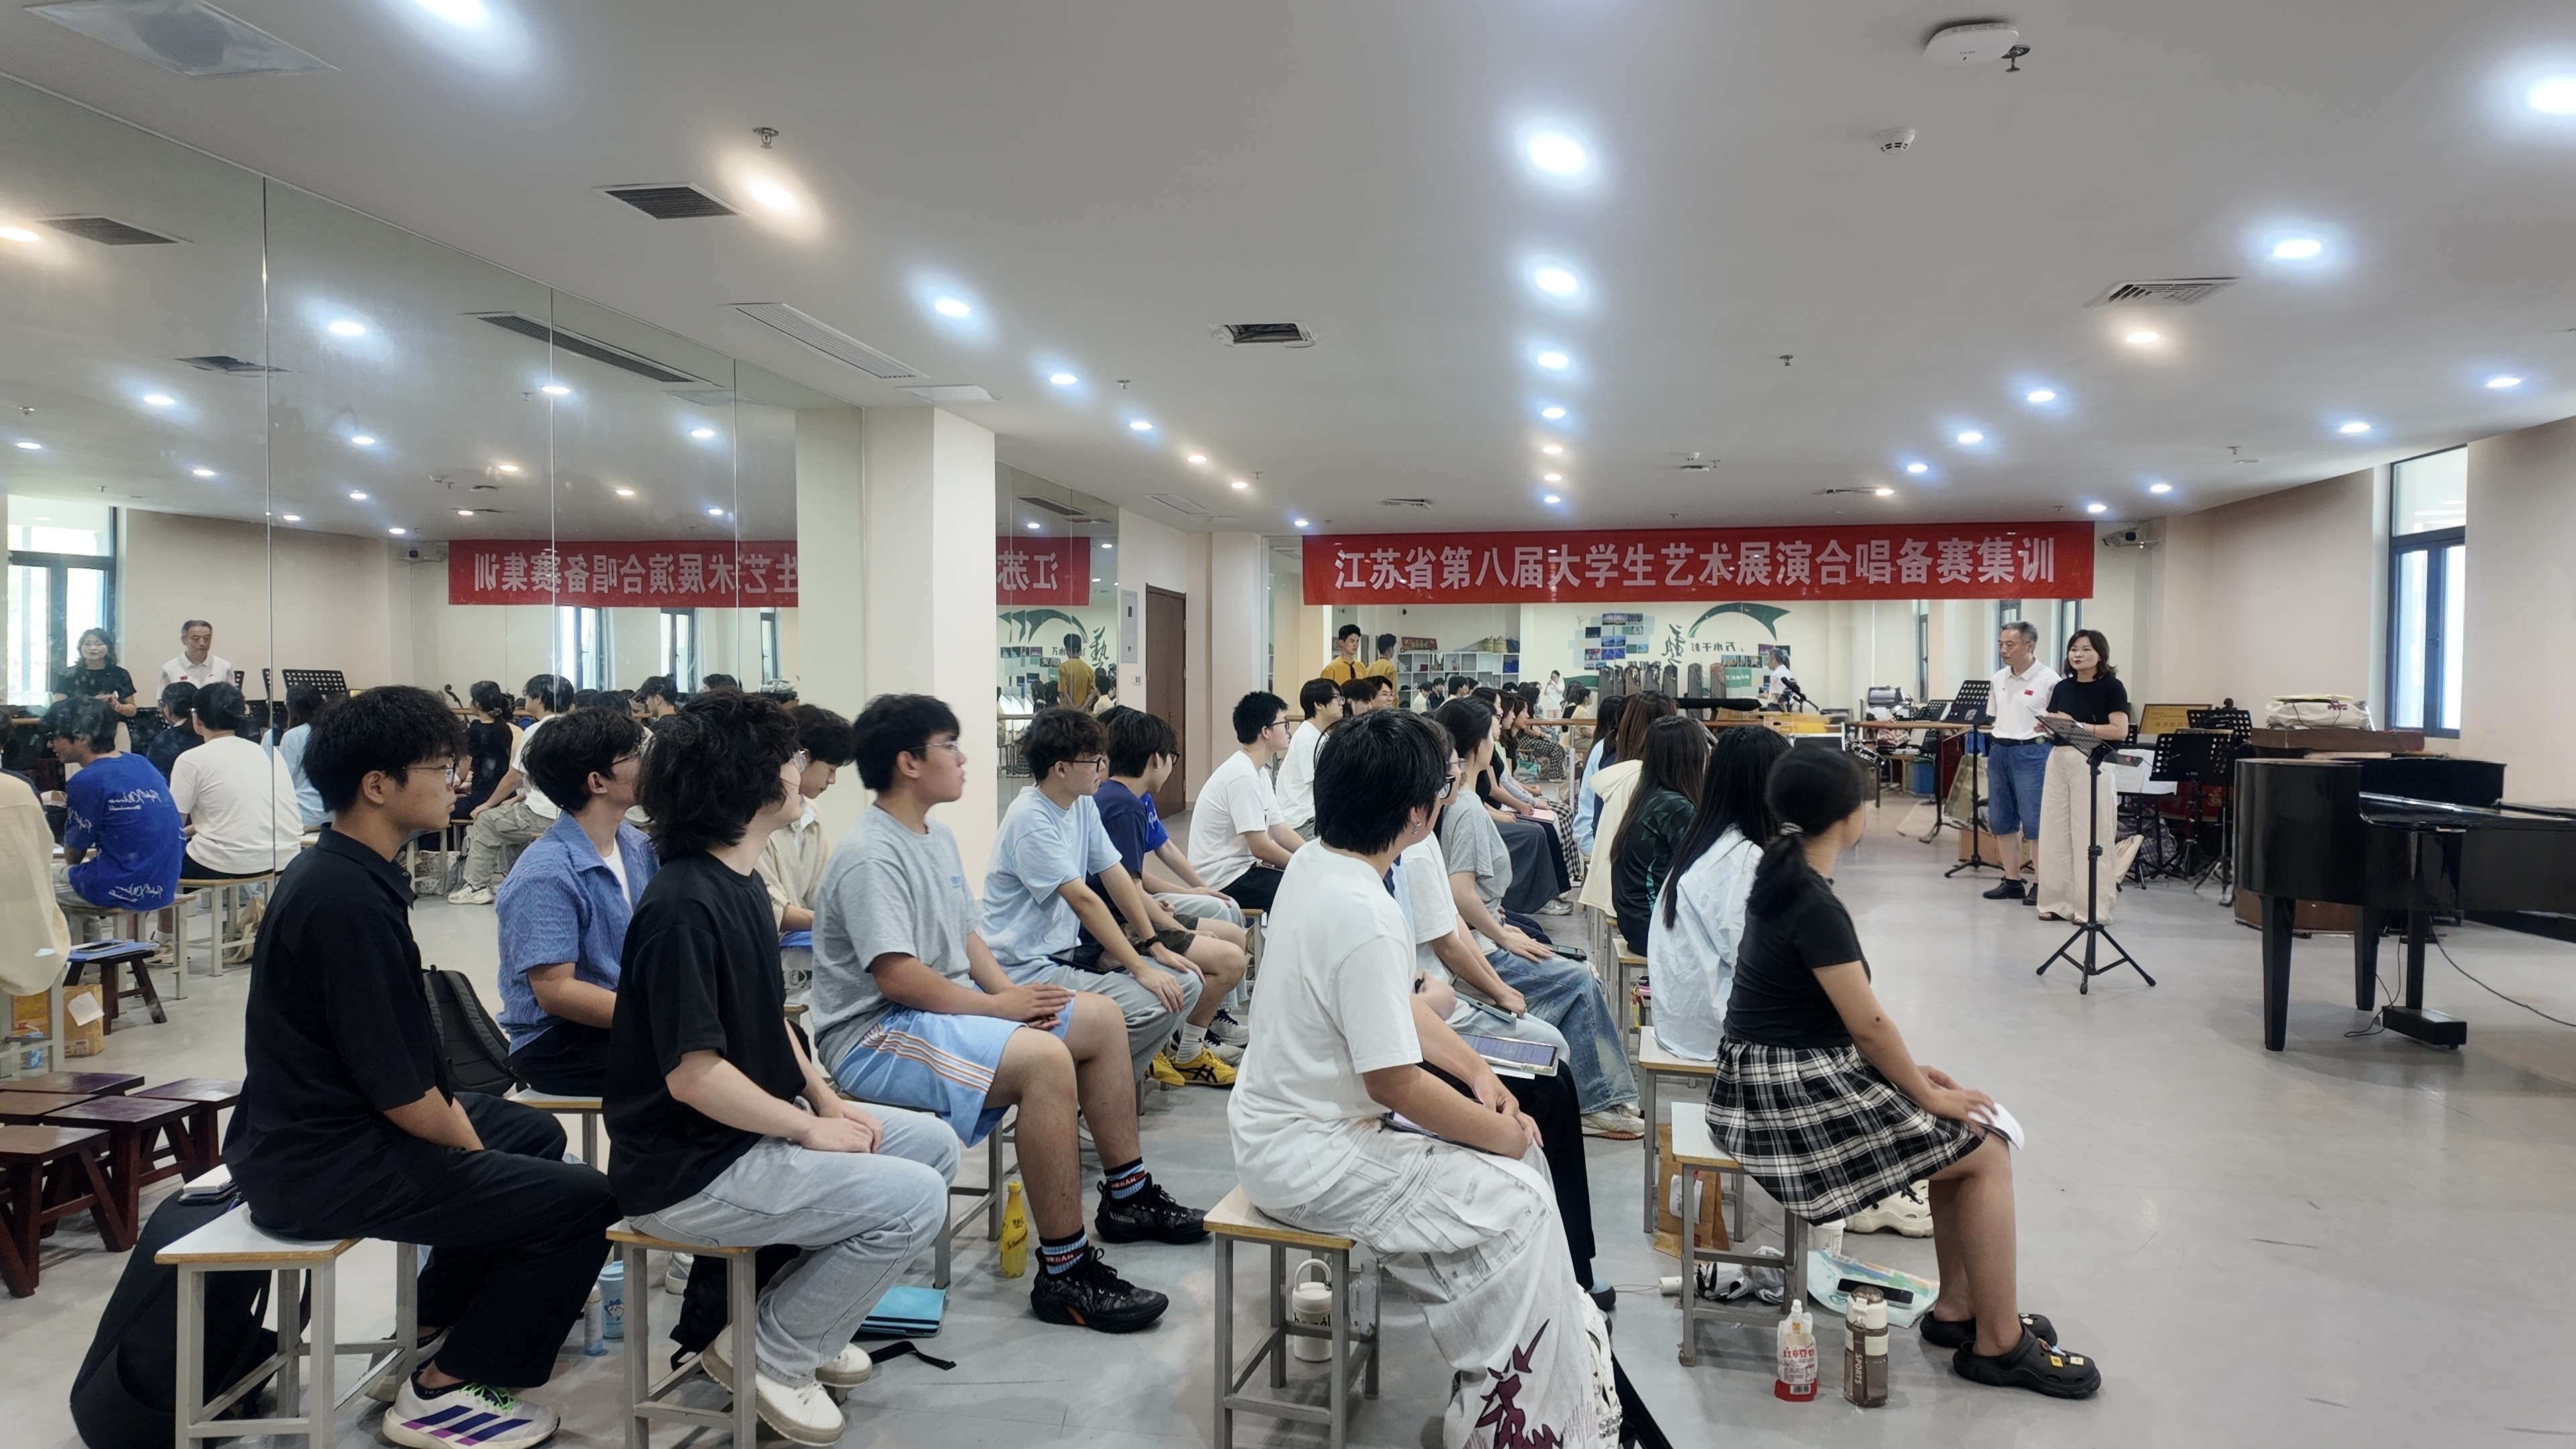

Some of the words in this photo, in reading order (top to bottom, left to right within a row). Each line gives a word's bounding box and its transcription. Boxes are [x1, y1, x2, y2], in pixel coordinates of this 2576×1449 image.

[1334, 536, 2054, 589] 江苏省第八届大学生艺术展演合唱备赛集训
[1854, 1352, 1863, 1385] SPORTS
